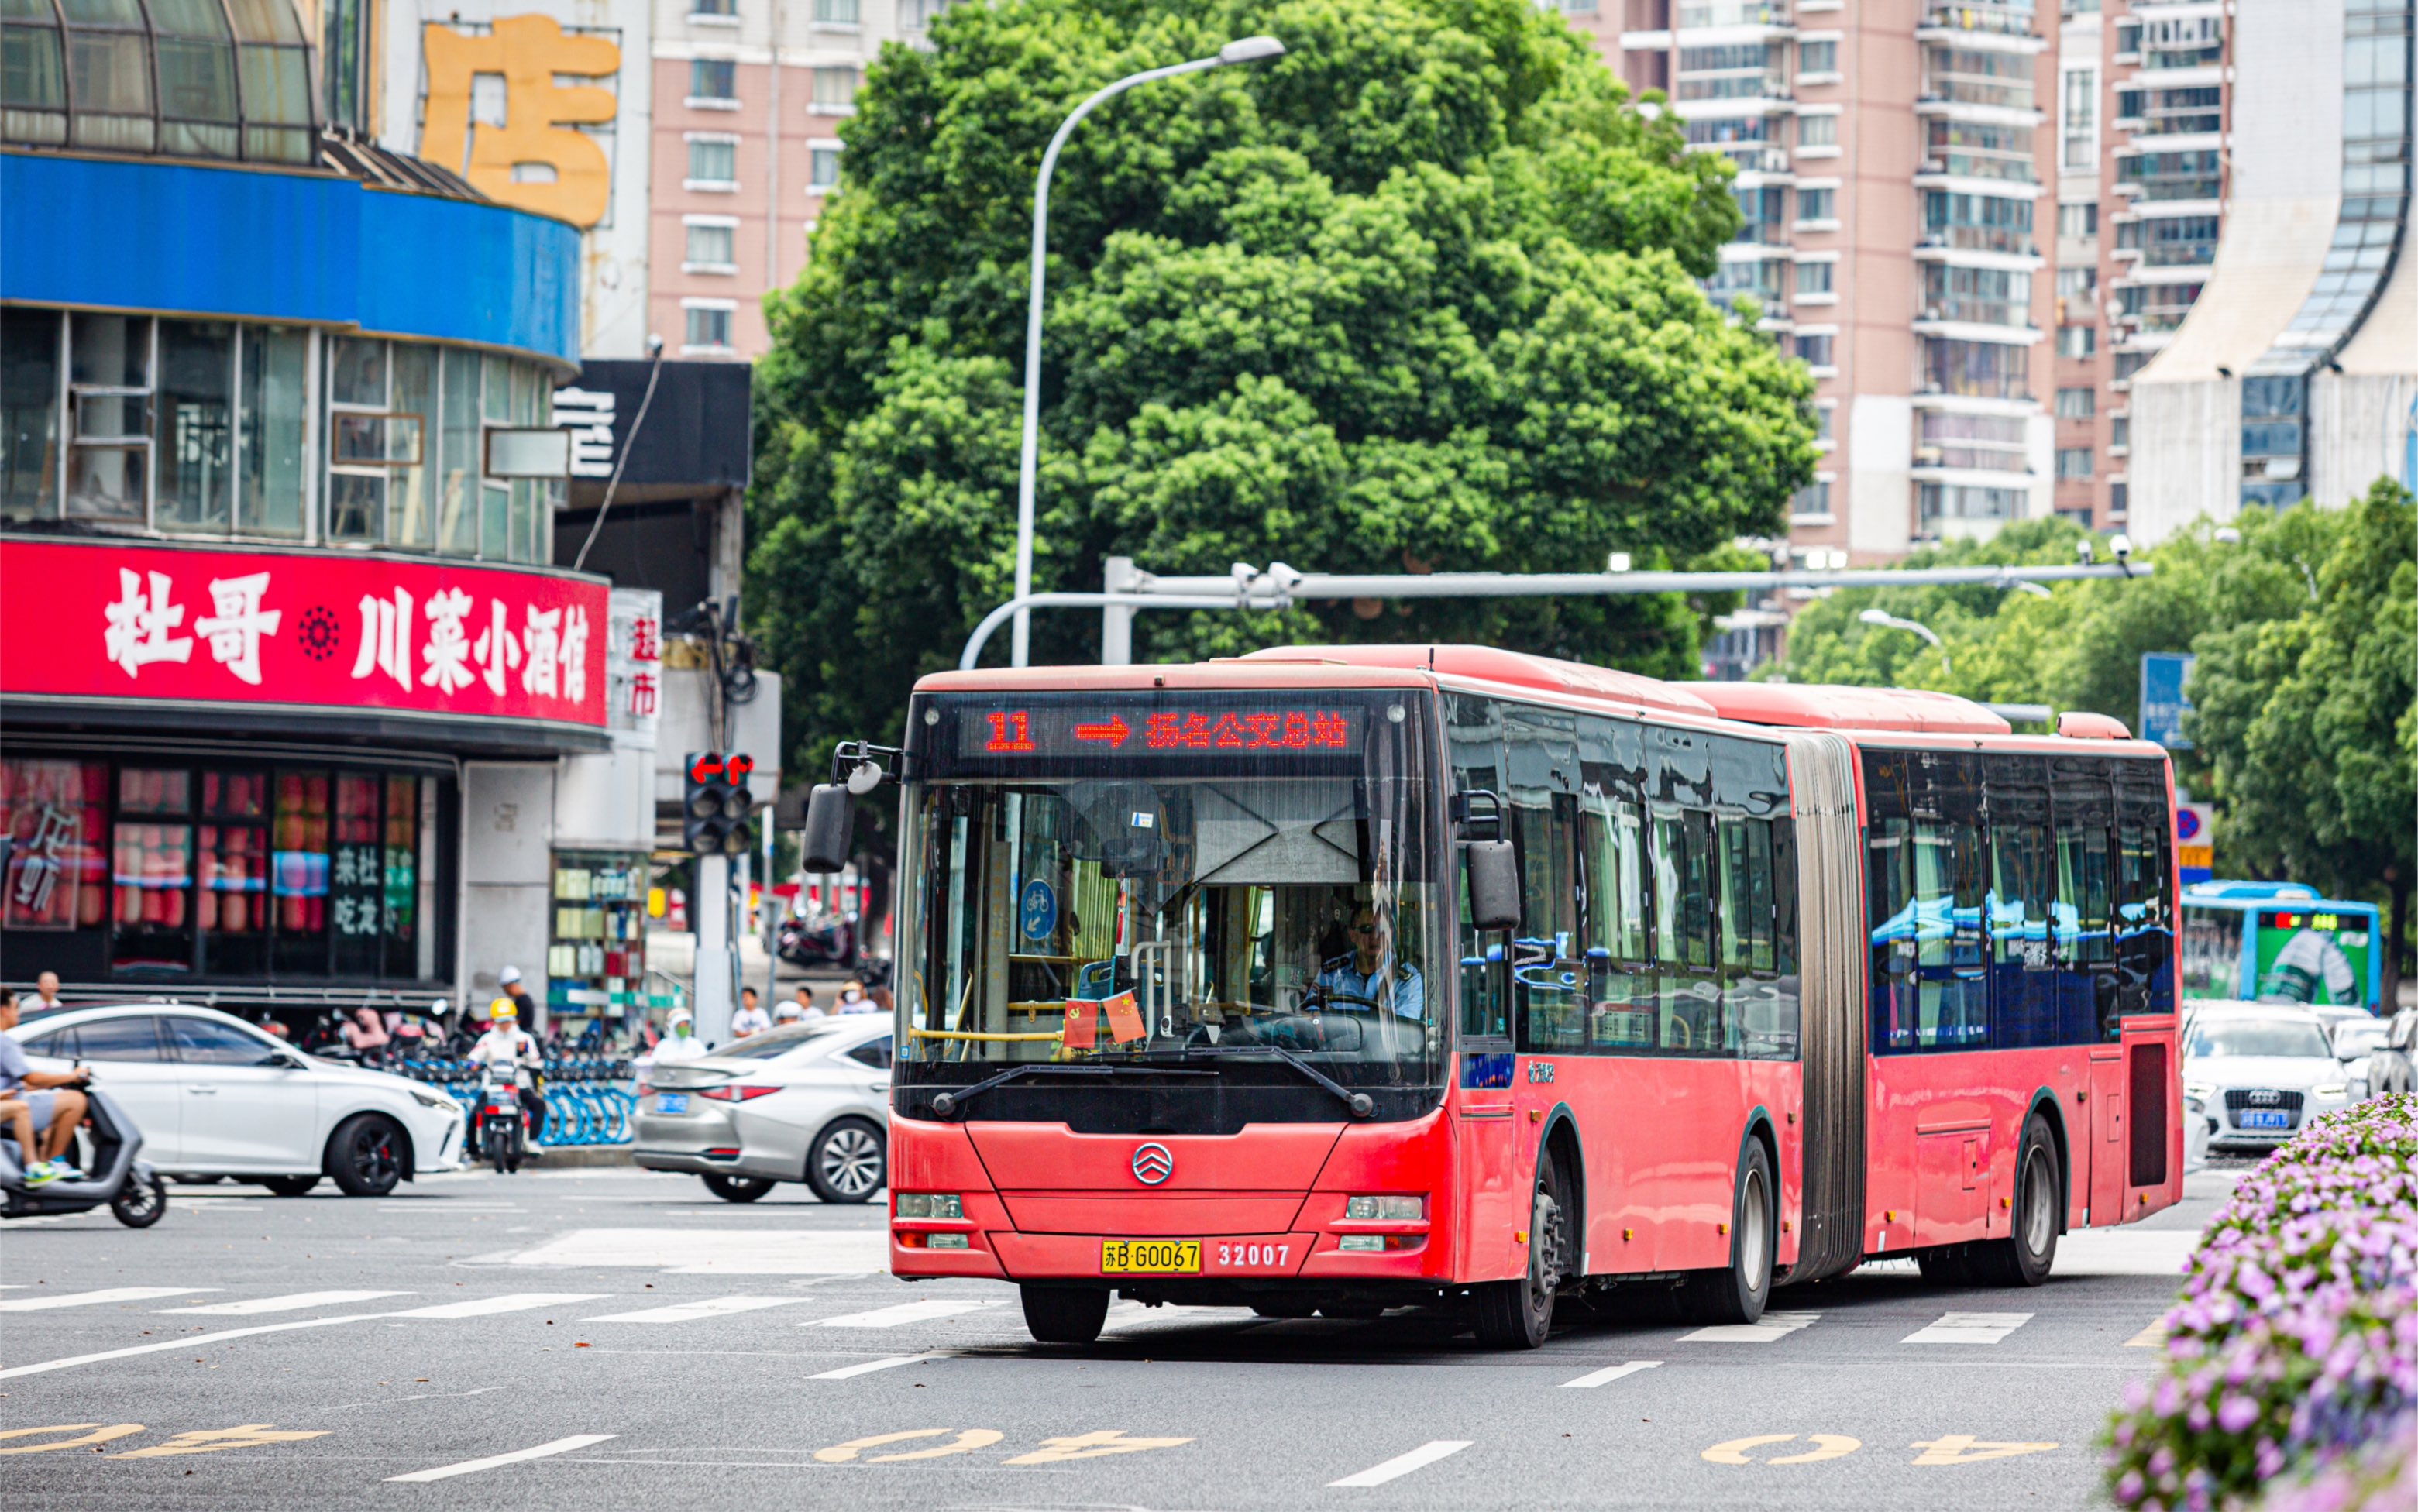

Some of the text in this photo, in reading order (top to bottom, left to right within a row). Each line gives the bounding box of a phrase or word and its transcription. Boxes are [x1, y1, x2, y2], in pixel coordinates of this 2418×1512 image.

[421, 14, 621, 227] 店
[105, 567, 589, 704] 杜哥 川菜小酒馆
[634, 617, 660, 715] 超市
[986, 711, 1035, 752] 11
[1144, 710, 1349, 749] 扬名公交总站
[1219, 1245, 1289, 1266] 32007
